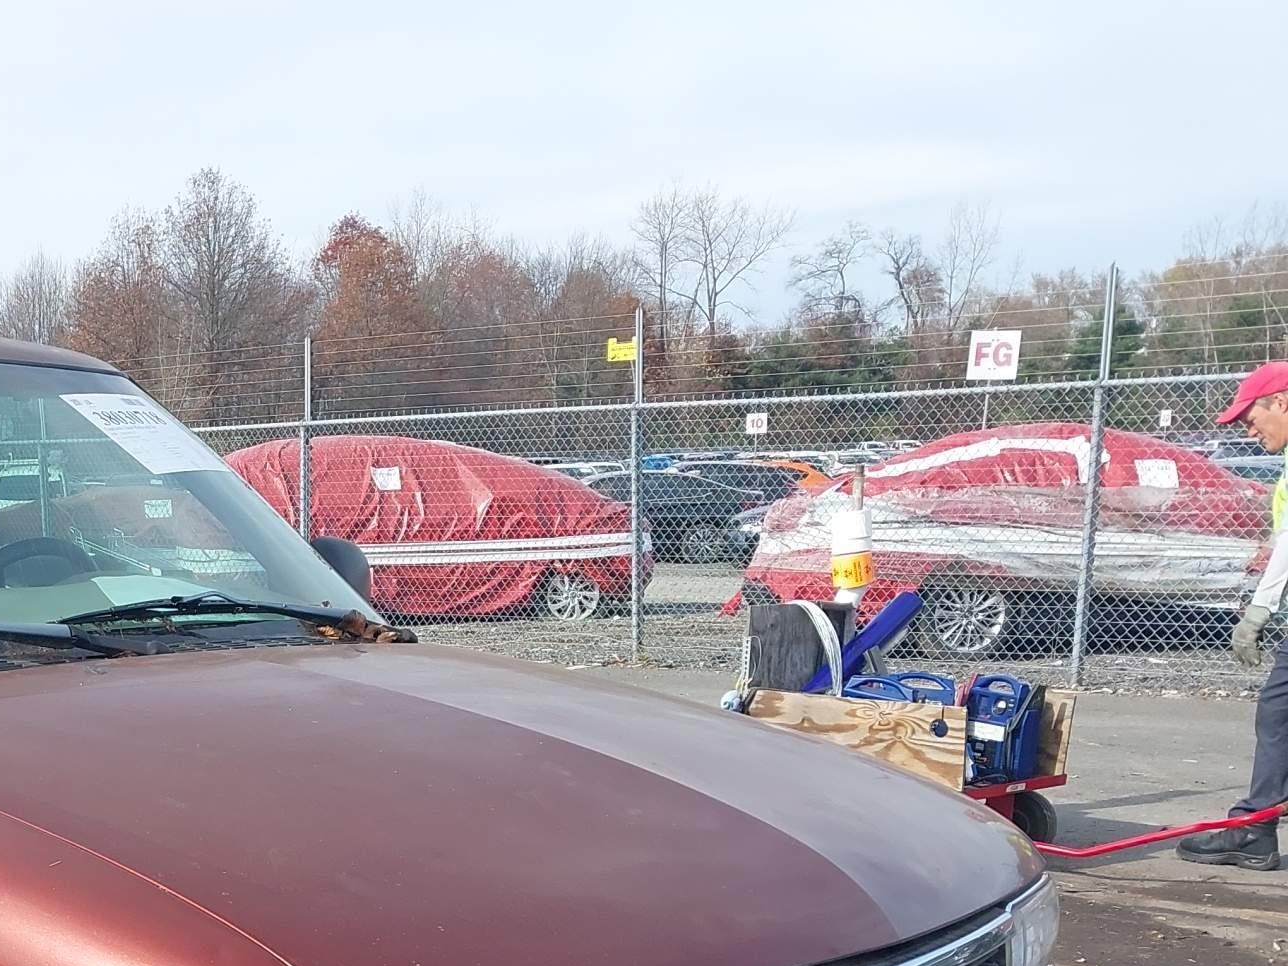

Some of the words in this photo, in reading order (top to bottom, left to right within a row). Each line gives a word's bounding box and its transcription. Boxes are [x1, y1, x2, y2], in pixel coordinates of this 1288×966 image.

[974, 341, 1013, 367] FG
[92, 409, 168, 427] 38030718
[751, 418, 764, 428] 10
